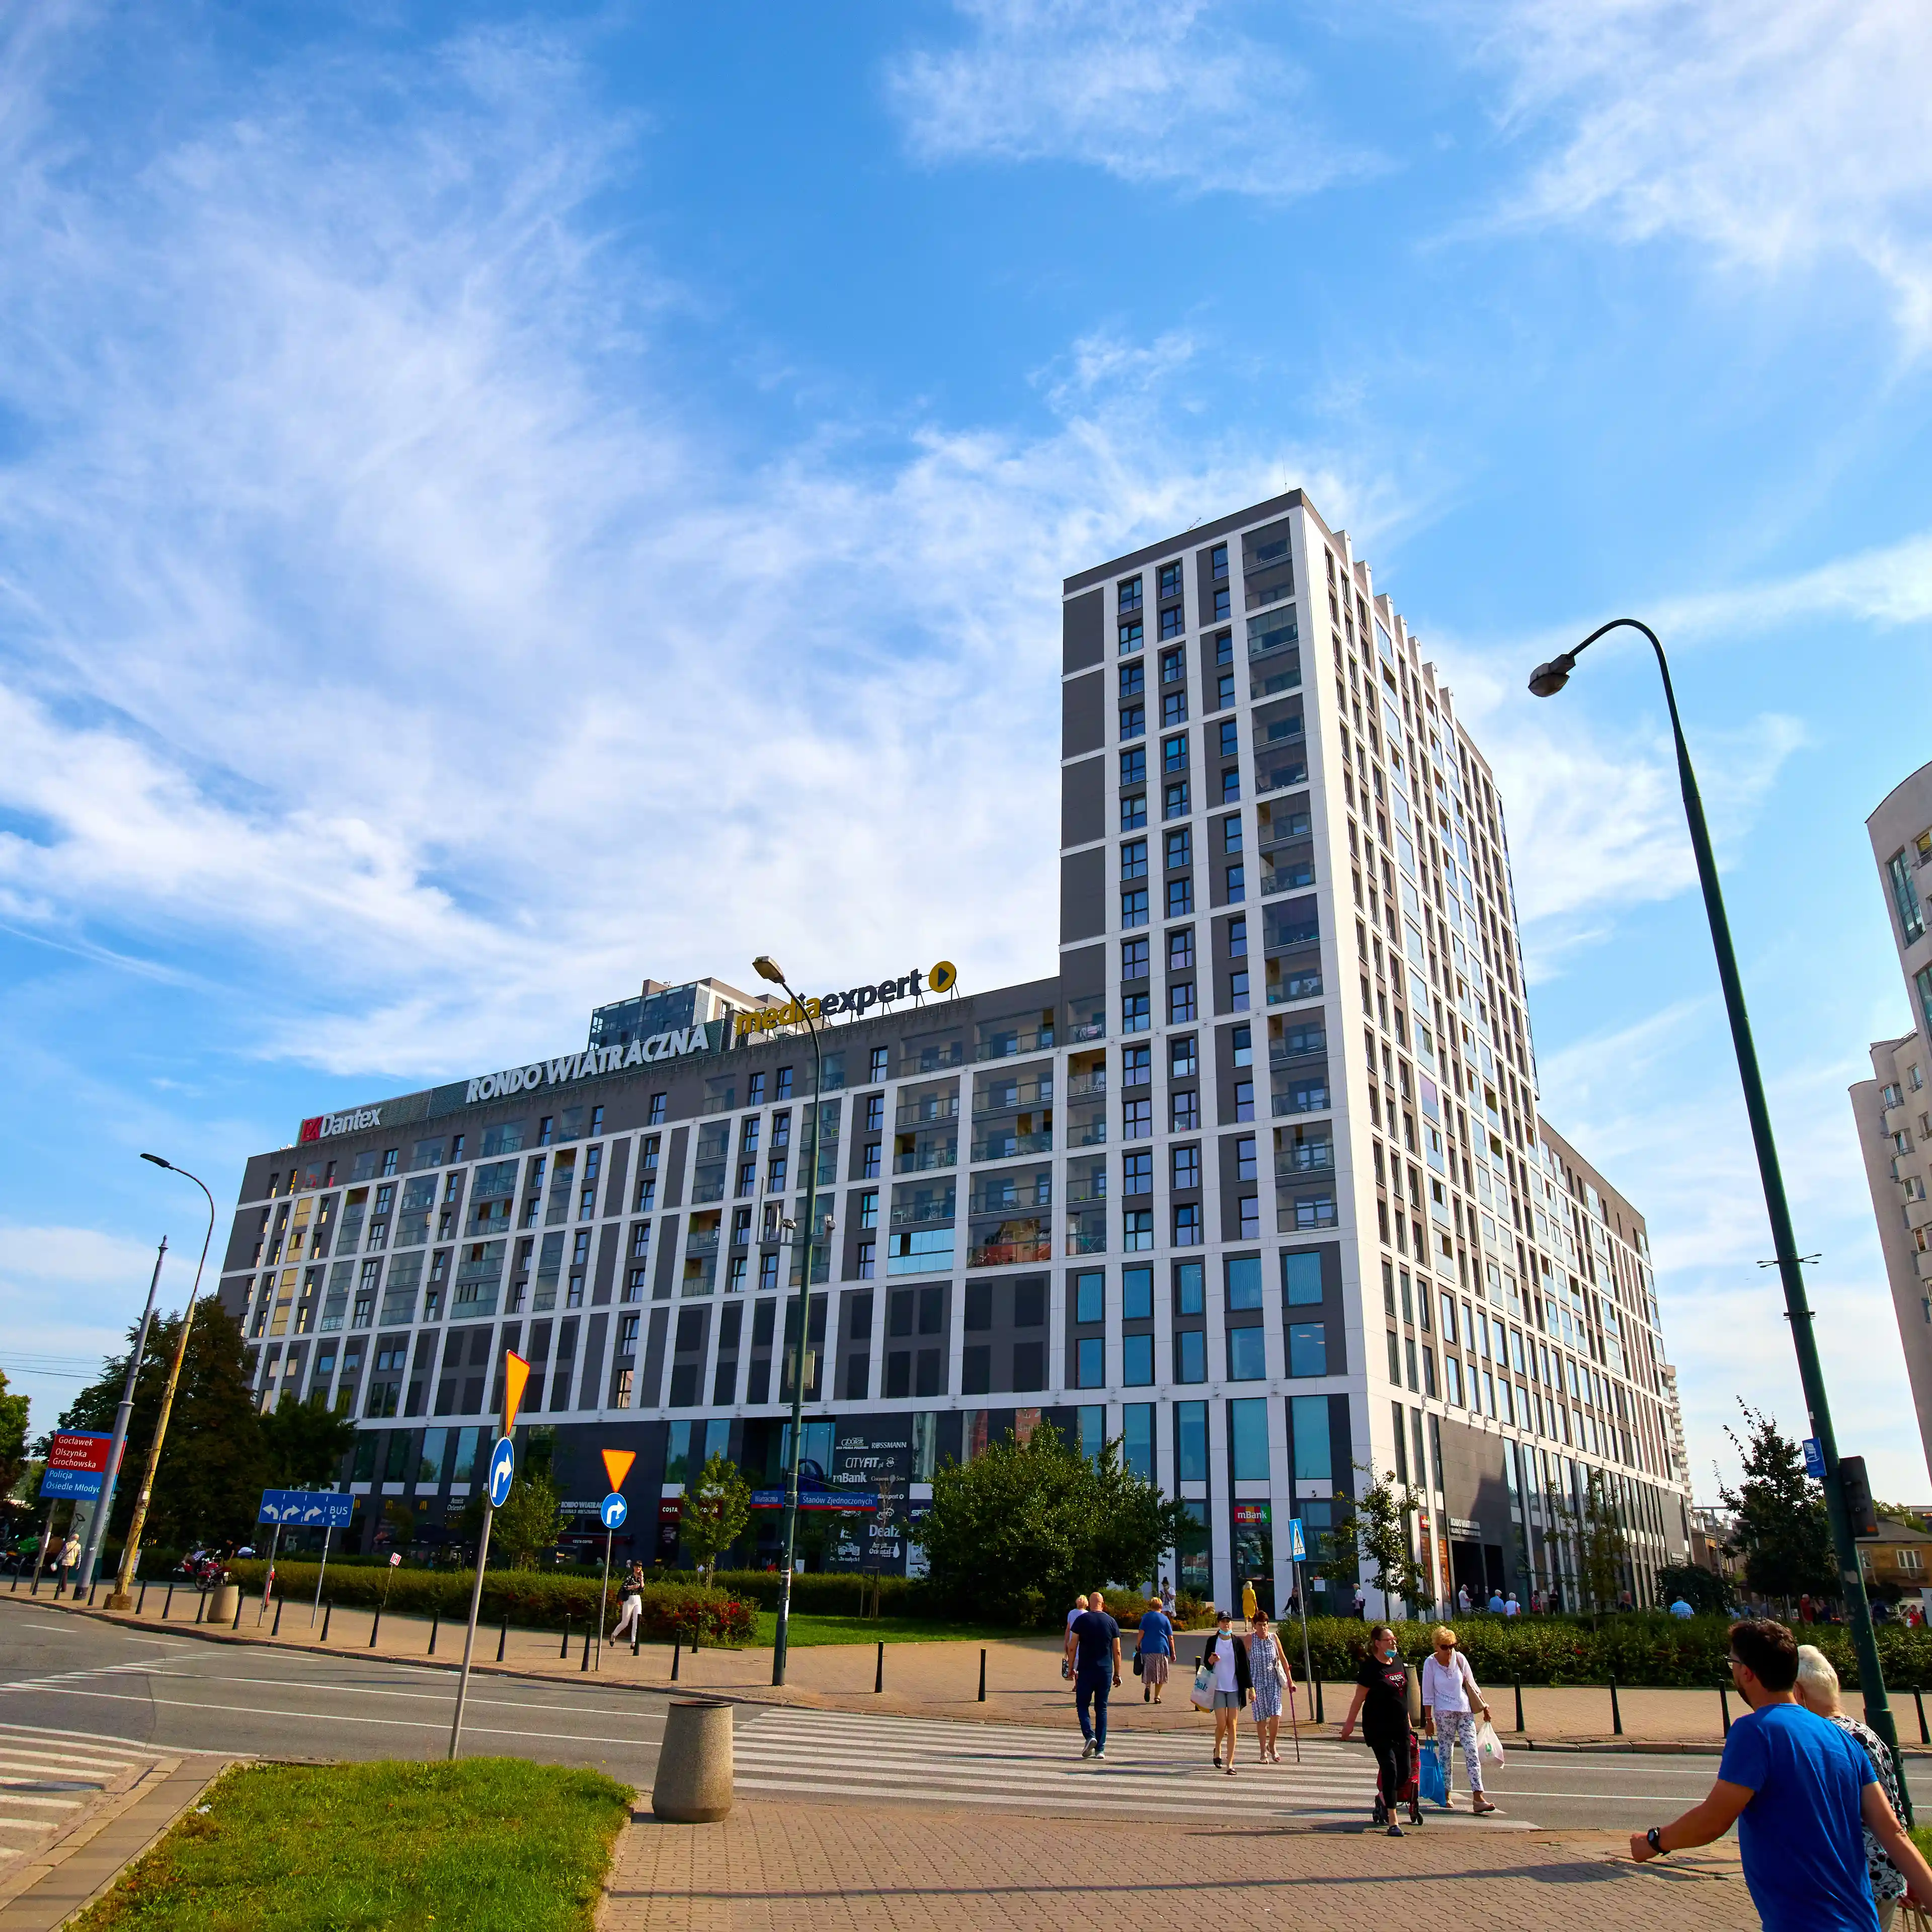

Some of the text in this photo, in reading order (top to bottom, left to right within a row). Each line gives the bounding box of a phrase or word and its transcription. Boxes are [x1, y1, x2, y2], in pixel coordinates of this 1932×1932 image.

[737, 969, 922, 1036] mediaexpert
[466, 1024, 709, 1103] RONDO WIATRACZNA
[319, 1108, 382, 1138] Dantex
[58, 1436, 94, 1446] Gocławek
[55, 1448, 87, 1458] Olszynka
[53, 1458, 96, 1468] Grochowska
[49, 1470, 73, 1480] Policja
[833, 1472, 868, 1483] mBank
[46, 1481, 100, 1495] Osiedle Młodyc
[827, 1496, 872, 1507] Zjednoczonych
[330, 1506, 348, 1515] BUS
[1237, 1511, 1267, 1519] mBank
[869, 1524, 901, 1537] Dealz
